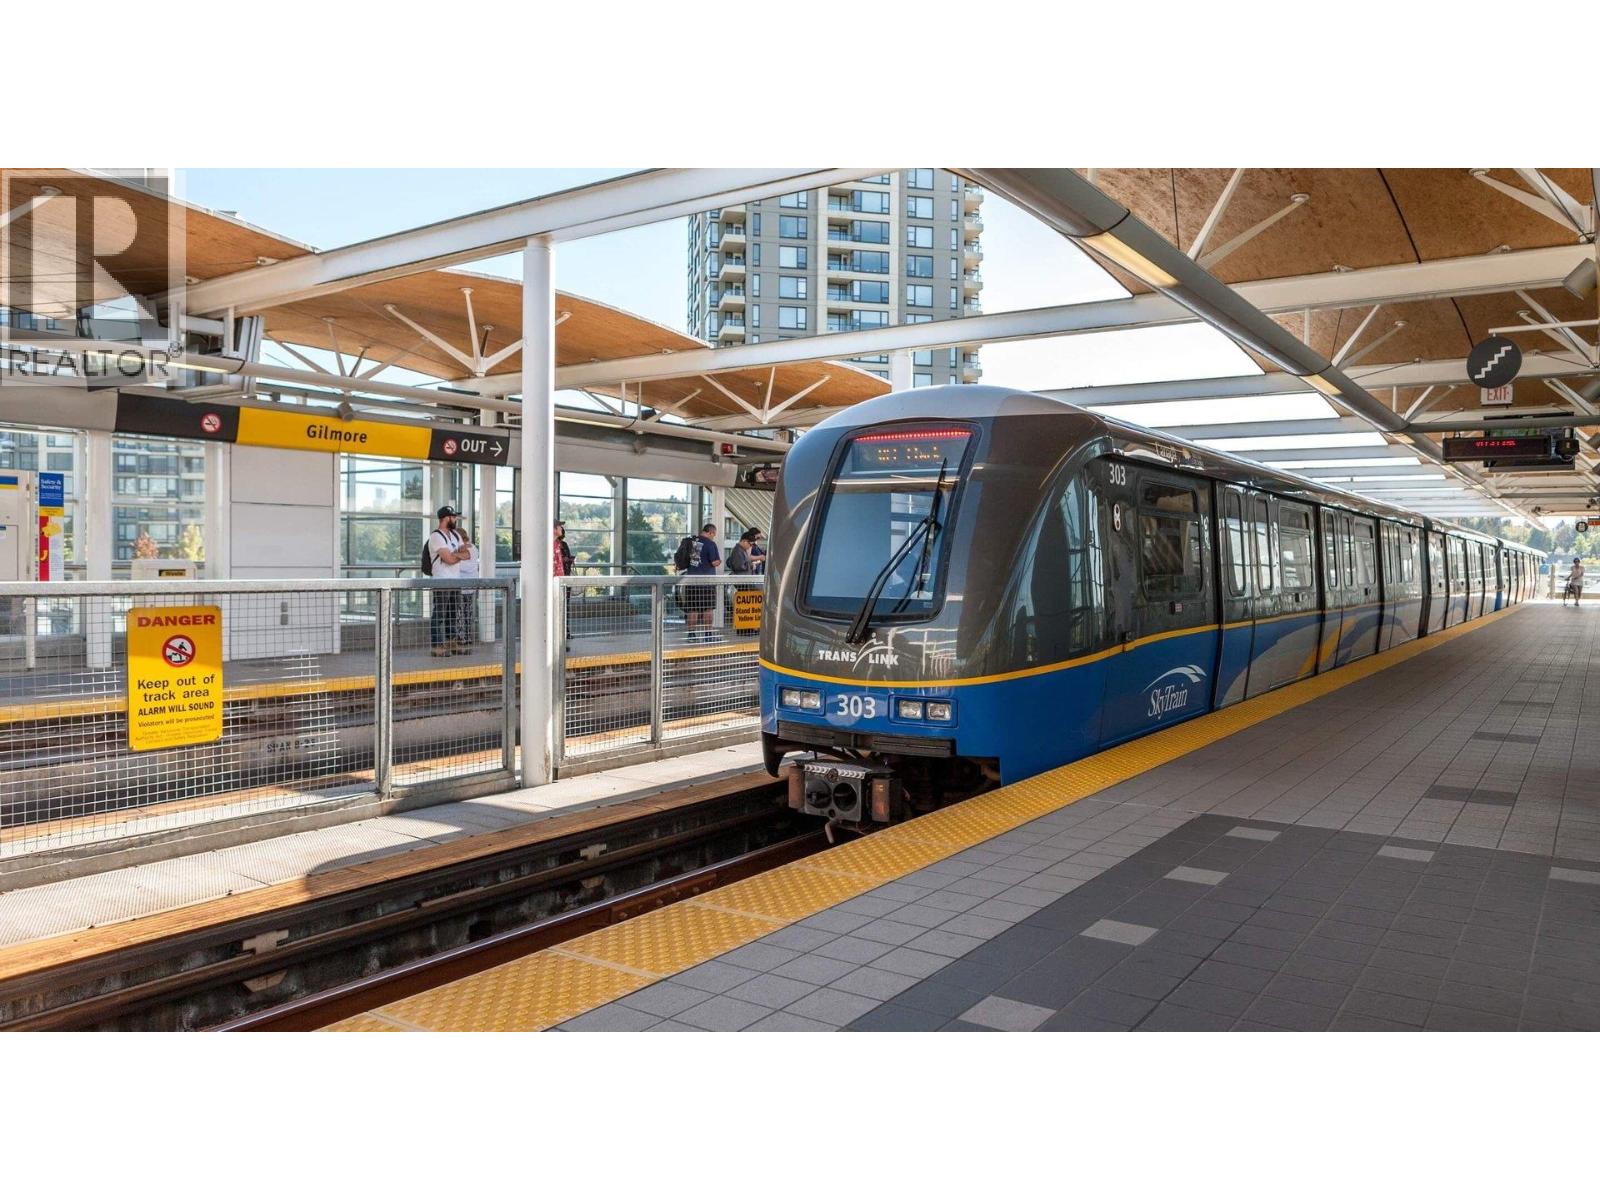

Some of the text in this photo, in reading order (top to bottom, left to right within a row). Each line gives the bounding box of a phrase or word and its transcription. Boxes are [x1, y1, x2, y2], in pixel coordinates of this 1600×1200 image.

[1487, 387, 1508, 401] EXIT
[307, 424, 368, 443] Gilmore
[461, 439, 487, 453] OUT
[1109, 463, 1126, 486] 303
[736, 595, 763, 604] CAUTIO
[137, 614, 216, 628] DANGER
[137, 674, 215, 690] Keep out of
[144, 688, 210, 702] track area
[1147, 683, 1188, 720] SkyTrain
[138, 701, 215, 717] ALARM WILL SOUND
[836, 694, 876, 719] 303
[137, 720, 164, 728] Violators
[184, 714, 215, 723] prosecuted
